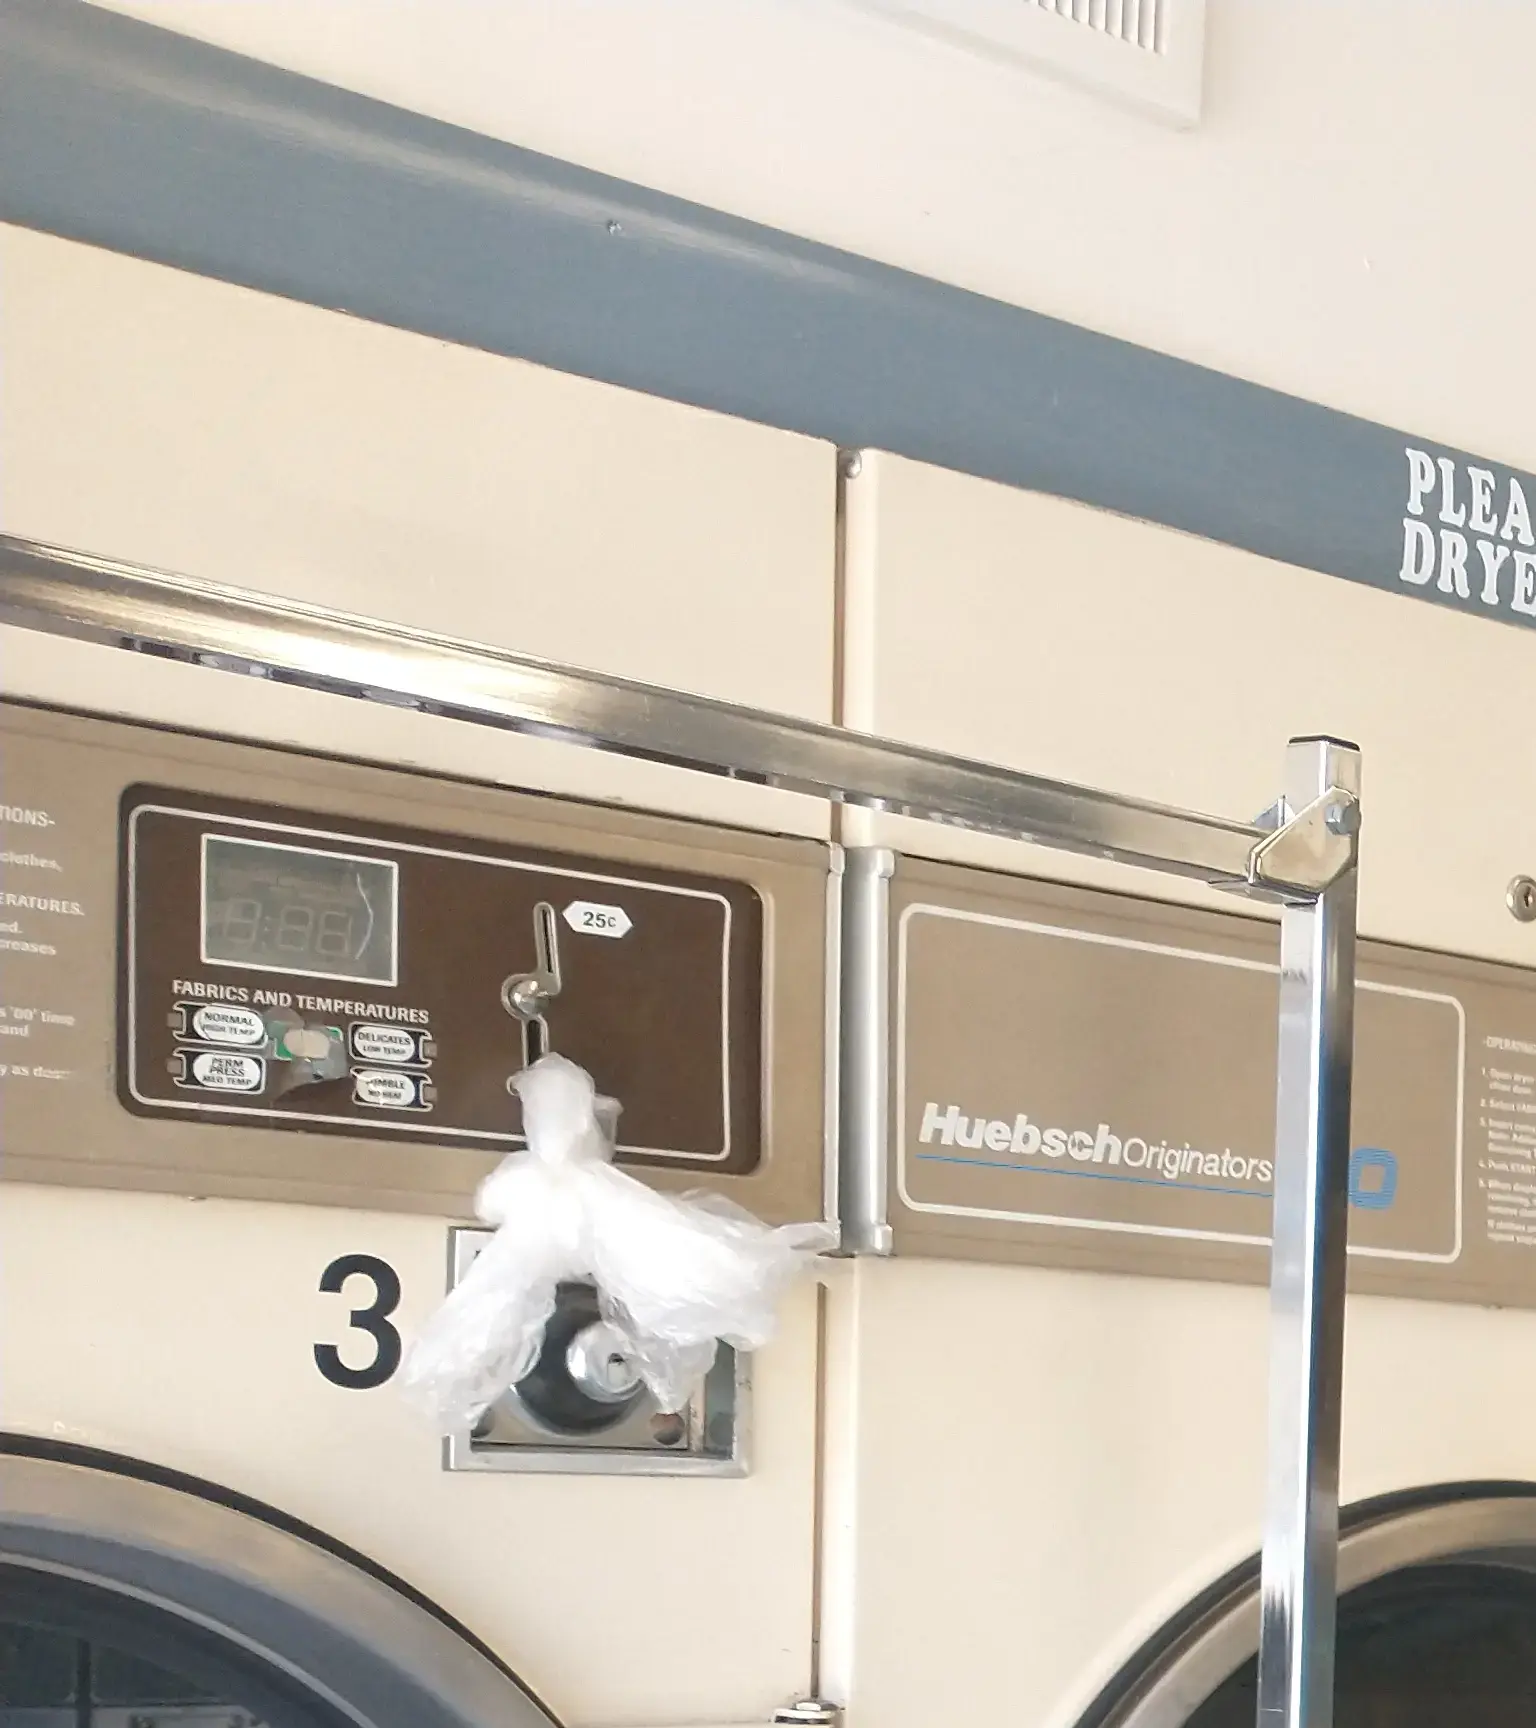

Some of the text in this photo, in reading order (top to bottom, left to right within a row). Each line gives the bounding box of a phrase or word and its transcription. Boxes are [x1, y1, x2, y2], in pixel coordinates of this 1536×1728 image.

[172, 979, 430, 1024] FABRICS AND TEMPERATURES
[203, 1011, 255, 1027] NORMAL
[358, 1031, 411, 1045] DELICATES
[209, 1066, 245, 1077] PRESS
[919, 1102, 1123, 1166] Huebsch
[1123, 1136, 1274, 1182] Originators
[312, 1254, 403, 1391] 3
